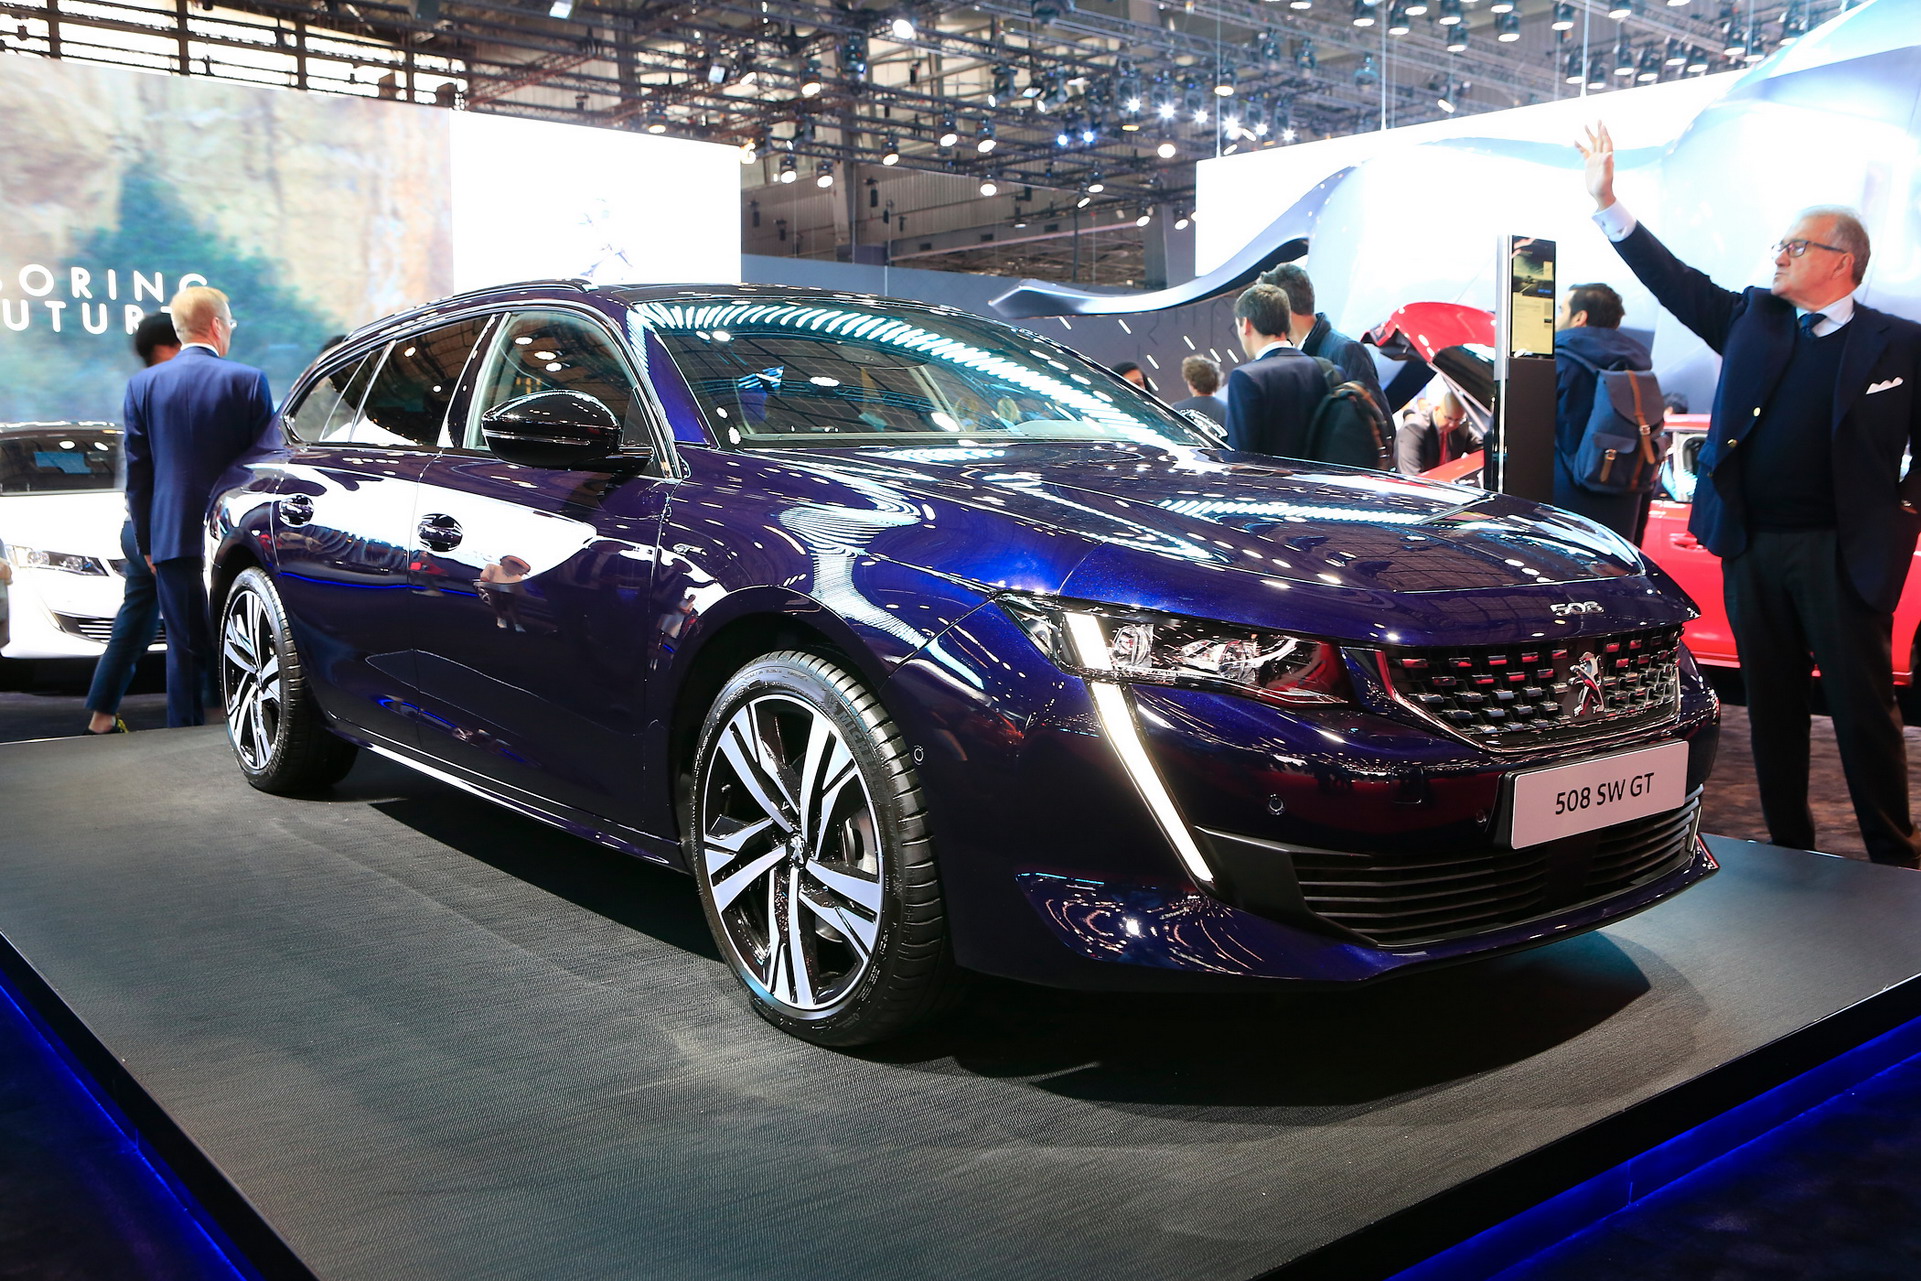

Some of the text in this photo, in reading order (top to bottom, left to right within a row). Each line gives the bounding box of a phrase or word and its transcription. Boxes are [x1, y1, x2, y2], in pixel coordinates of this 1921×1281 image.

[2, 298, 173, 335] UTUR
[1550, 601, 1604, 617] 508
[1555, 772, 1655, 815] 508 SW GT
